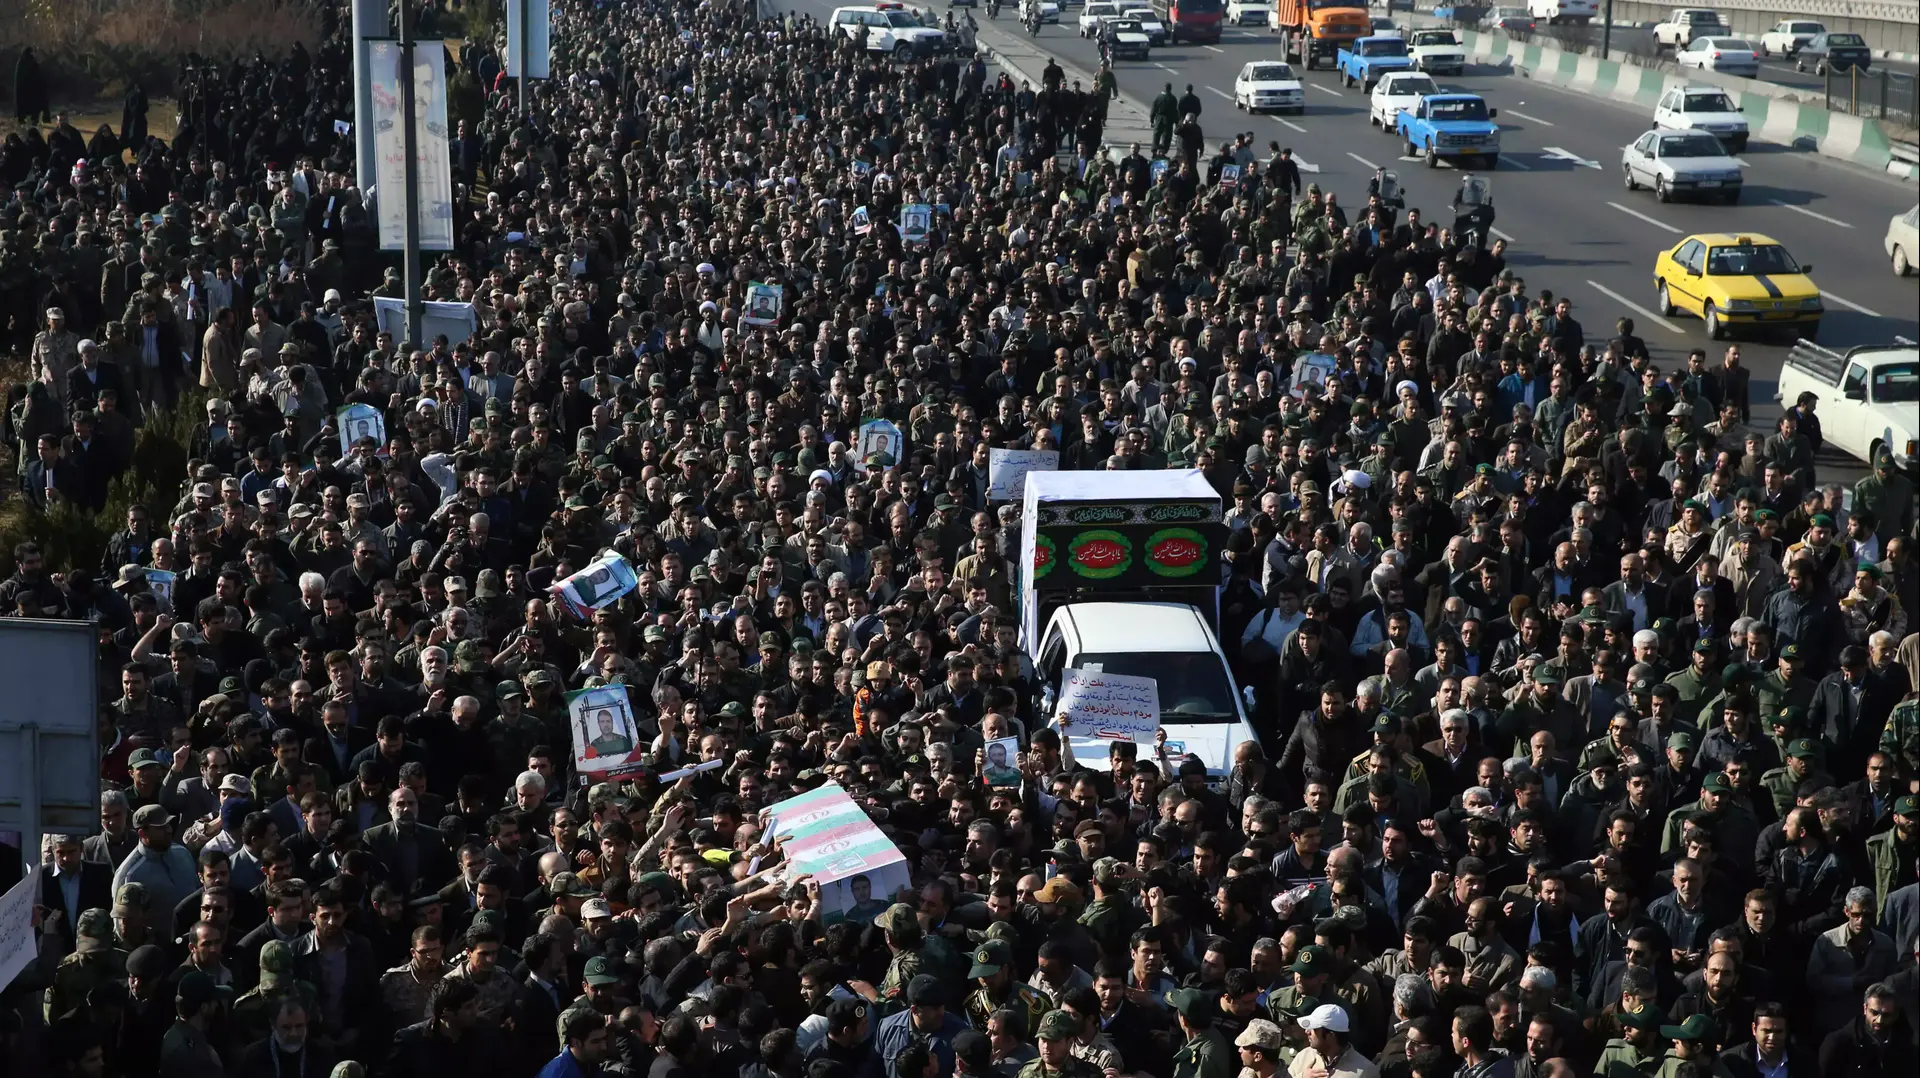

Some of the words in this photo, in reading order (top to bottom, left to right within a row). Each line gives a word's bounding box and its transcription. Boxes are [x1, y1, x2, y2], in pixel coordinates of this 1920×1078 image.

[1071, 675, 1090, 689] ایران
[1089, 678, 1104, 687] ملت
[1134, 682, 1150, 692] عزت
[1132, 695, 1152, 707] نتیجه
[1133, 709, 1152, 721] مردم
[1122, 721, 1132, 734] باج
[1139, 723, 1154, 732] است
[1084, 727, 1136, 742] استکبار
